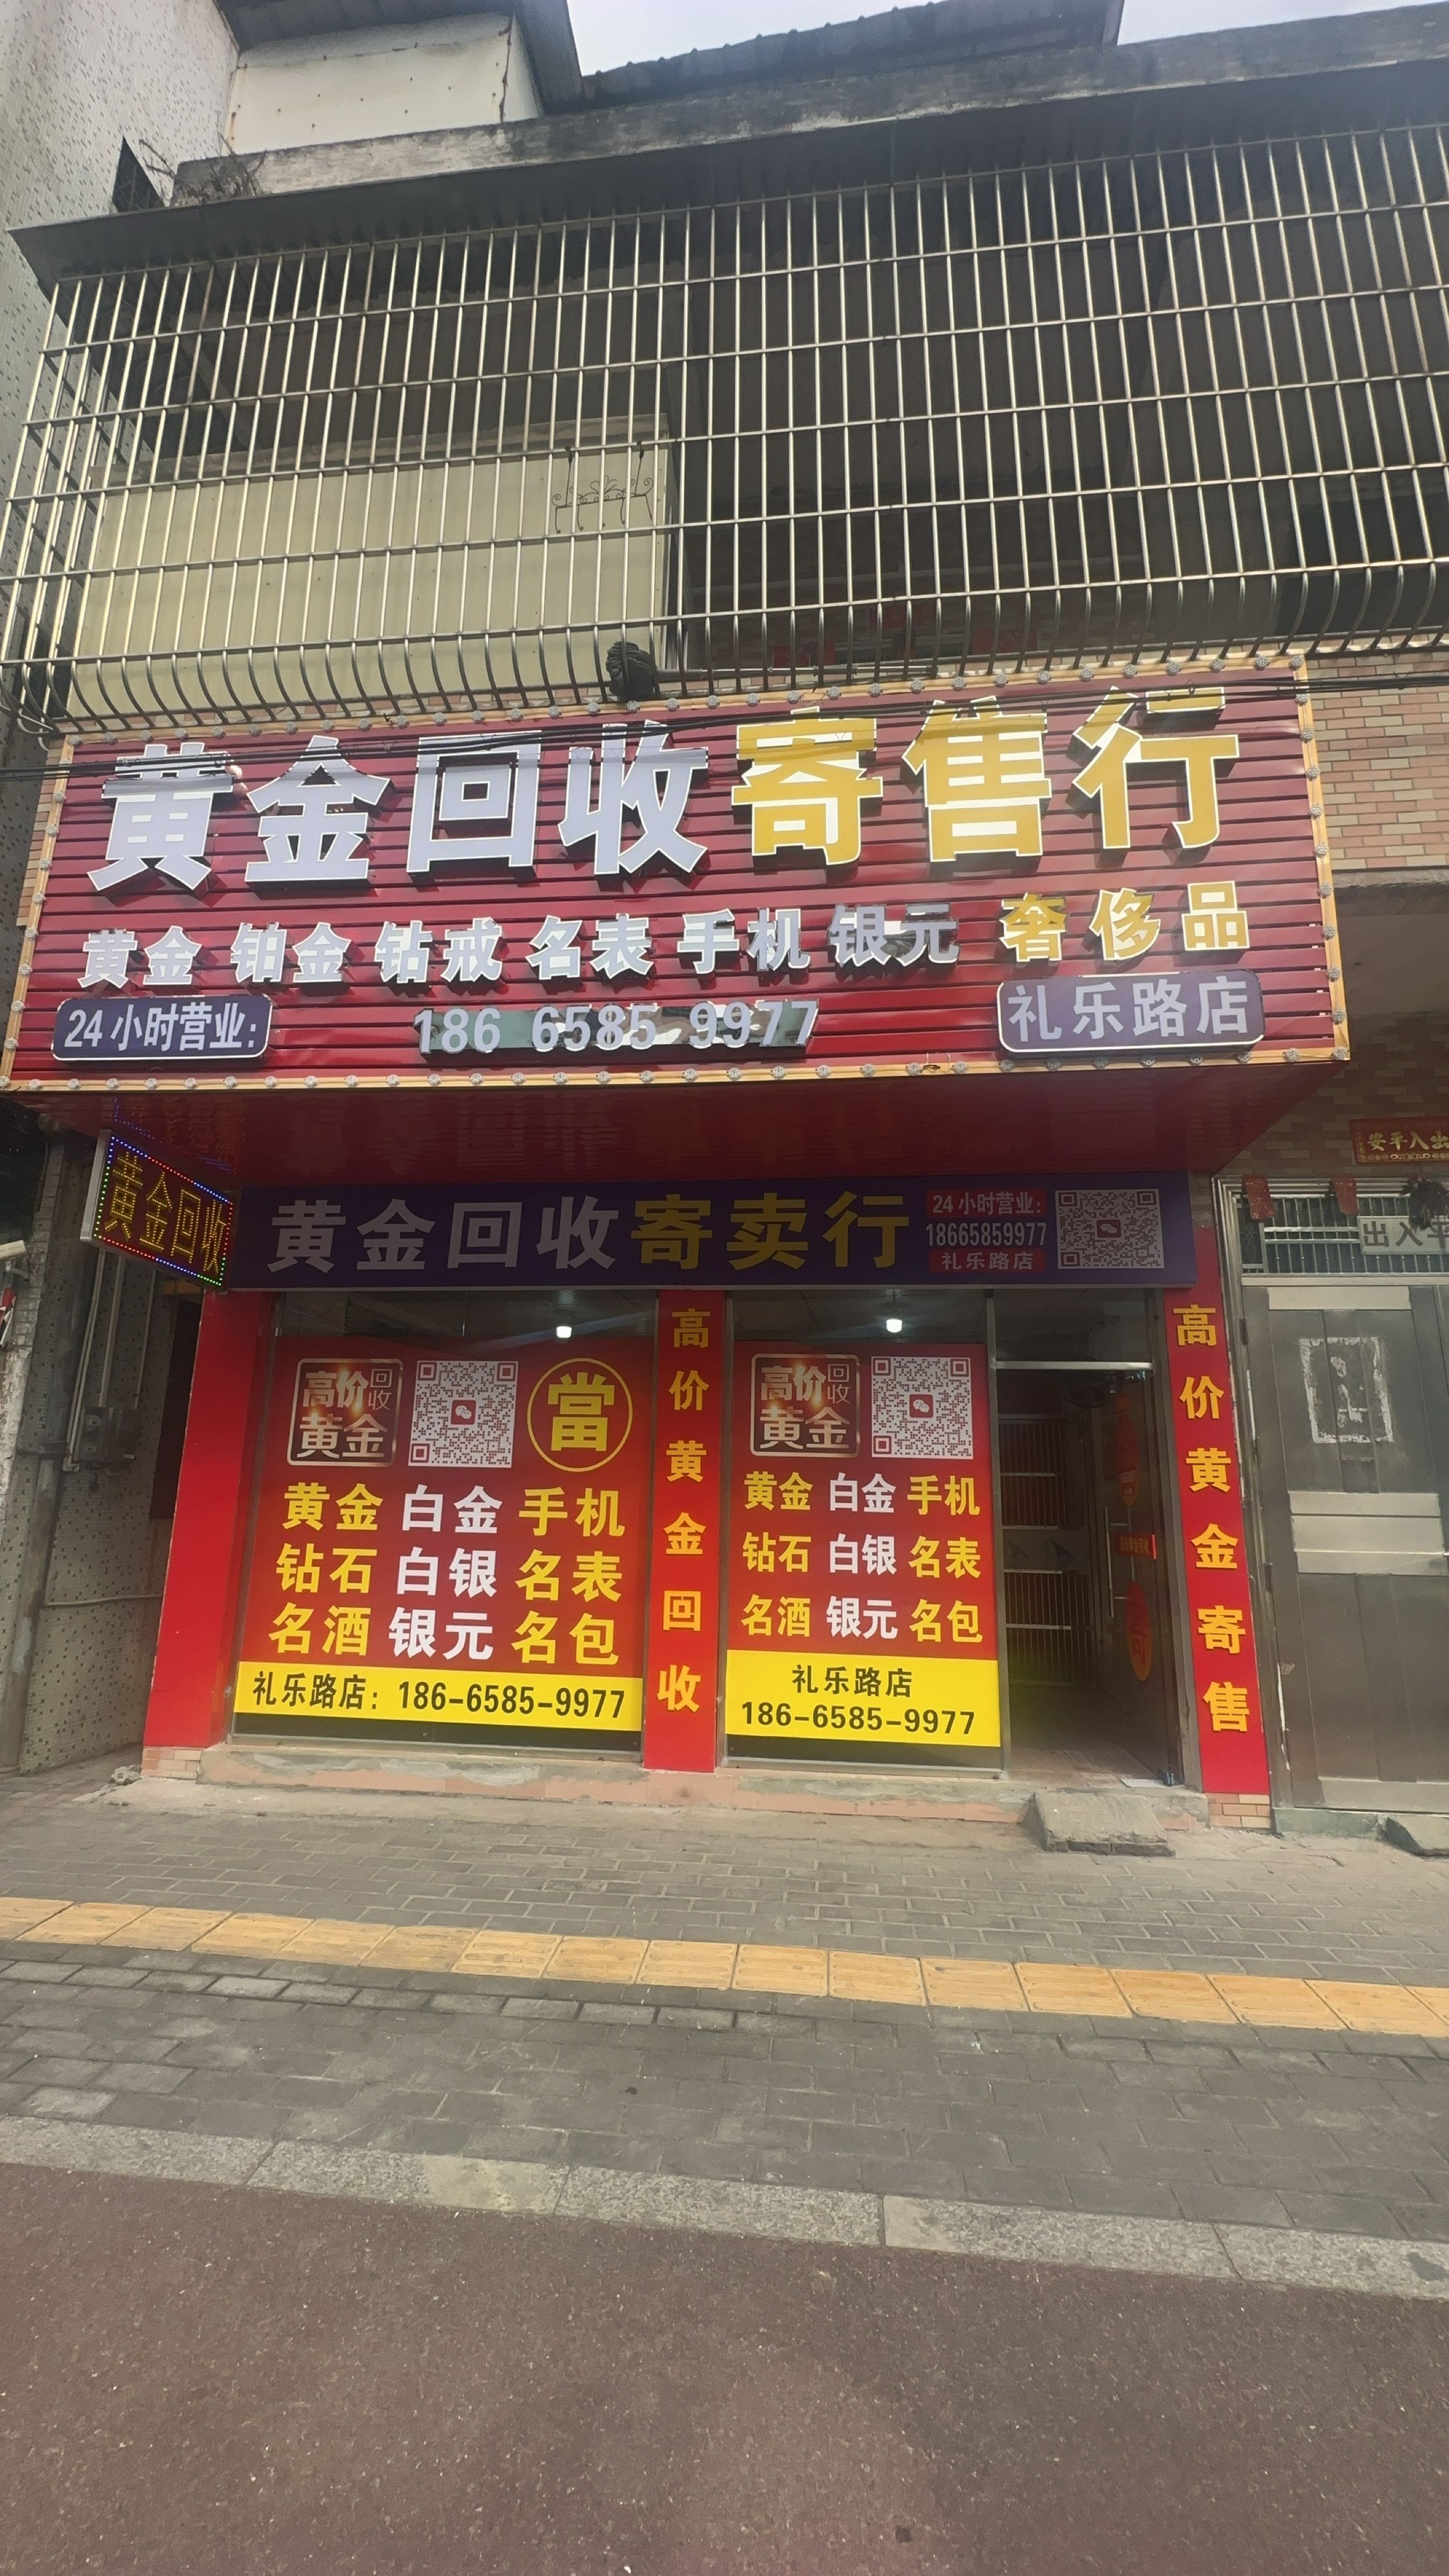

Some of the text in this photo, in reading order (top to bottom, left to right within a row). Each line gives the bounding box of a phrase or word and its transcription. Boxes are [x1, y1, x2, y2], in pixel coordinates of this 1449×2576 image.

[87, 685, 1240, 892] 黄金回收寄售行
[79, 880, 1250, 989] 黄金 铂金 钻戒 名表 手机 银元 奢侈品
[413, 999, 818, 1054] 186 6585 9977
[1007, 976, 1249, 1043] 礼乐路店
[105, 1151, 226, 1274] 黄金回收
[267, 1190, 910, 1273] 黄金回收寄卖行
[926, 1221, 1047, 1247] 18665859977
[941, 1251, 1034, 1270] 礼乐路店
[302, 1370, 369, 1410] 高价
[760, 1365, 826, 1402] 高价
[296, 1413, 389, 1460] 黄金
[547, 1371, 616, 1451] 當
[759, 1406, 851, 1450] 黄金
[283, 1482, 625, 1538] 黄金 白金 手机
[657, 1308, 708, 1713] 高价黄金回收
[744, 1471, 980, 1517] 黄金 白金 手机
[1173, 1304, 1250, 1732] 高价黄金寄售
[276, 1543, 623, 1602] 钻石 白银 名表
[743, 1532, 981, 1579] 钻石 白银 名表
[269, 1602, 620, 1665] 名酒 银元 名包
[741, 1594, 983, 1643] 名酒 银元 名包
[252, 1671, 625, 1719] 礼乐路店: 186-6585-9977
[792, 1664, 912, 1697] 礼乐路店
[742, 1701, 975, 1735] 186-6585-9977
